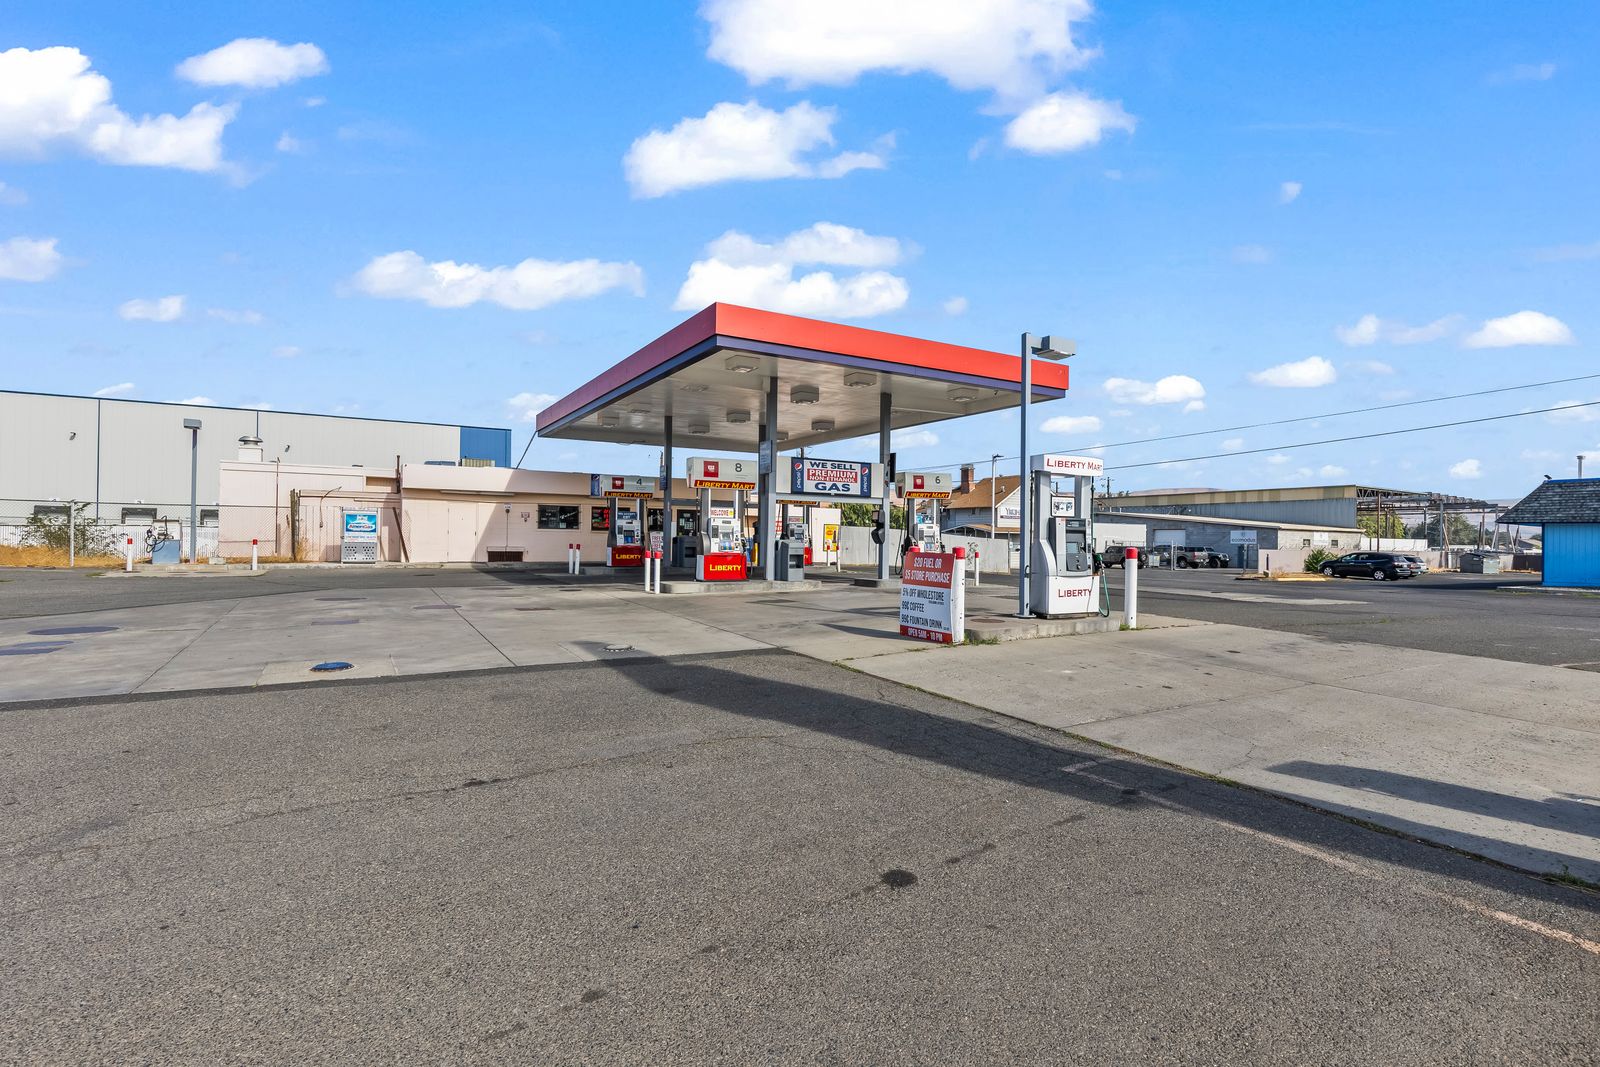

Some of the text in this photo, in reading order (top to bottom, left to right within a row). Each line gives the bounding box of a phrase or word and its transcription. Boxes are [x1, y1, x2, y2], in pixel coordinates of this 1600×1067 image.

[735, 462, 742, 472] 8
[809, 461, 856, 471] WE SELL
[1046, 458, 1086, 470] LIBERTY
[809, 469, 856, 479] PREMIUM
[809, 475, 856, 483] NON-ETHANOL
[696, 480, 755, 490] LIBERTY MART
[935, 476, 941, 484] 6
[814, 482, 851, 492] GAS
[923, 558, 934, 568] FUEL
[935, 558, 943, 568] OR
[911, 570, 925, 580] STORE
[925, 571, 950, 583] PURCHASE
[1058, 588, 1092, 598] LIBERTY
[909, 602, 925, 612] COFFEE
[910, 616, 929, 626] FOUNTAIN
[929, 619, 943, 629] DRINK
[936, 633, 943, 641] PM
